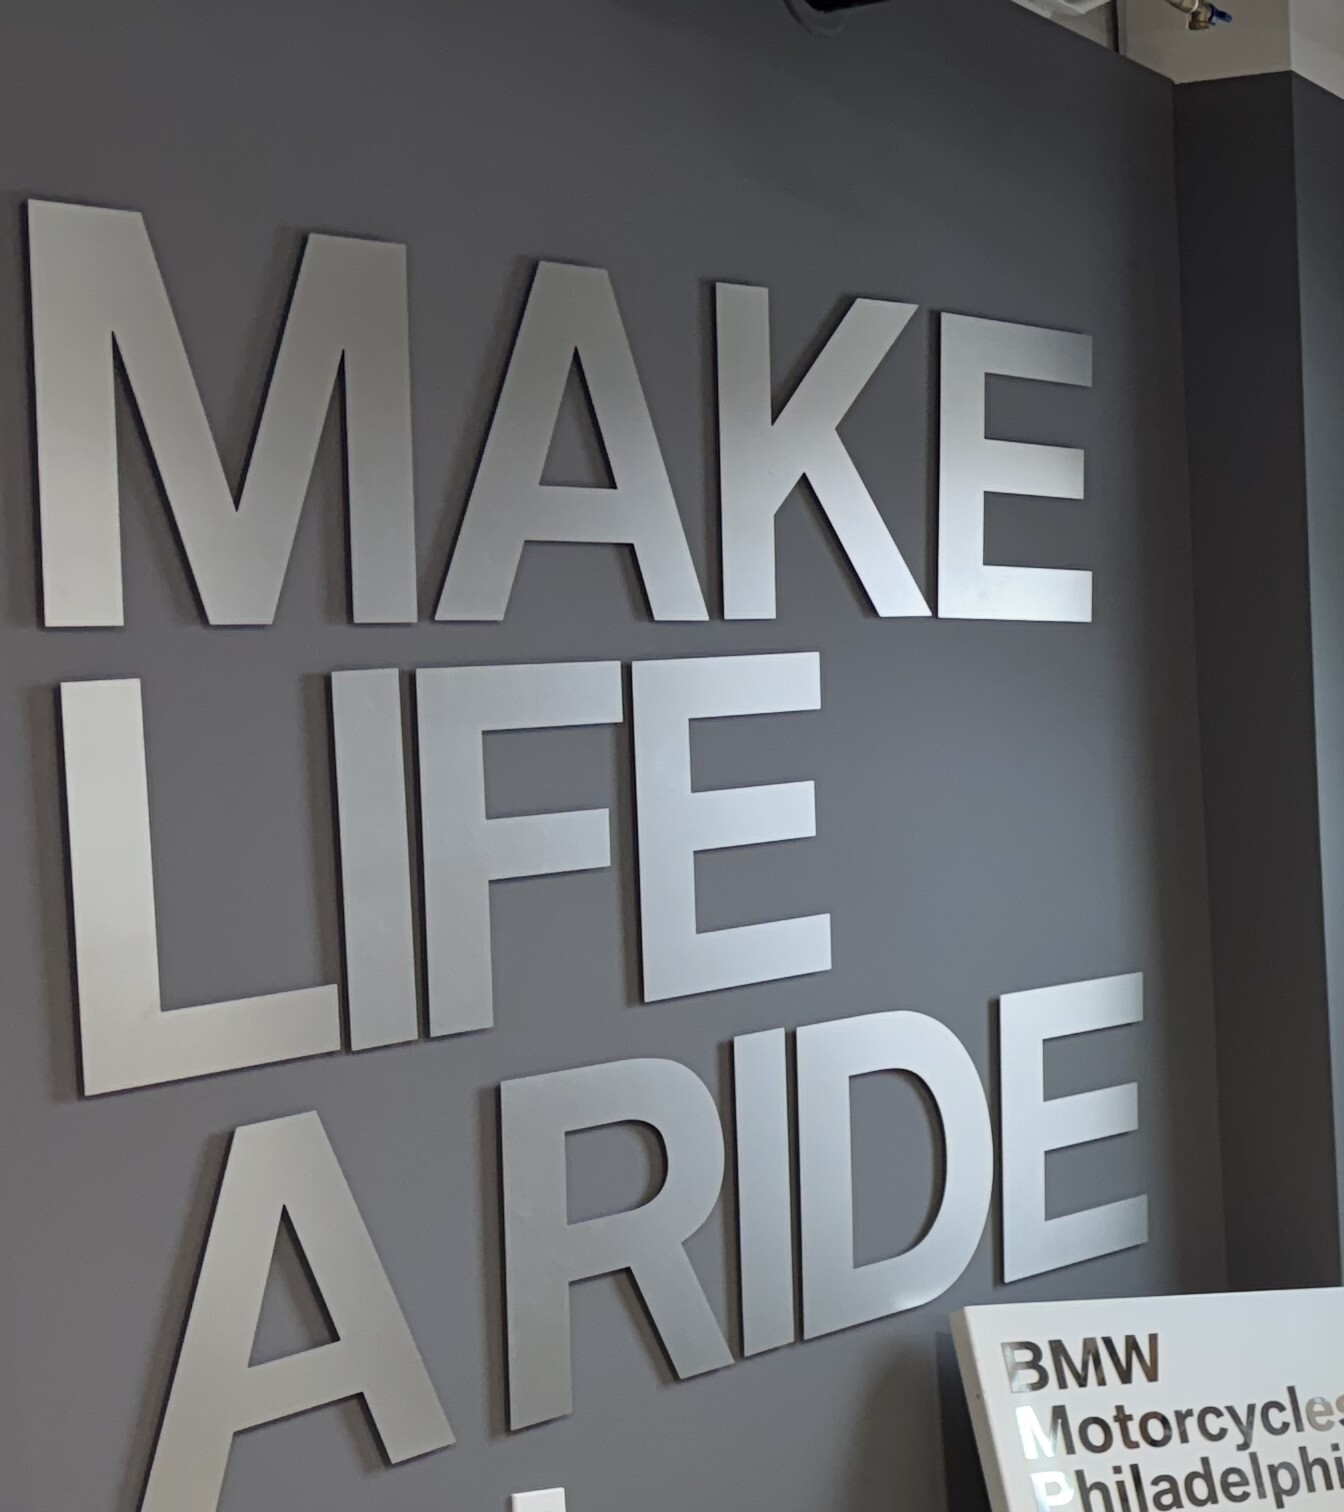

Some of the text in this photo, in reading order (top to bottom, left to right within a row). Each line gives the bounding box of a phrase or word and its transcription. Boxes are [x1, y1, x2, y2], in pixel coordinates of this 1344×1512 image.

[28, 198, 1093, 627] MAKE
[60, 651, 832, 1096] LIFE
[500, 972, 1149, 1432] RIDE
[1001, 1333, 1159, 1393] BMW
